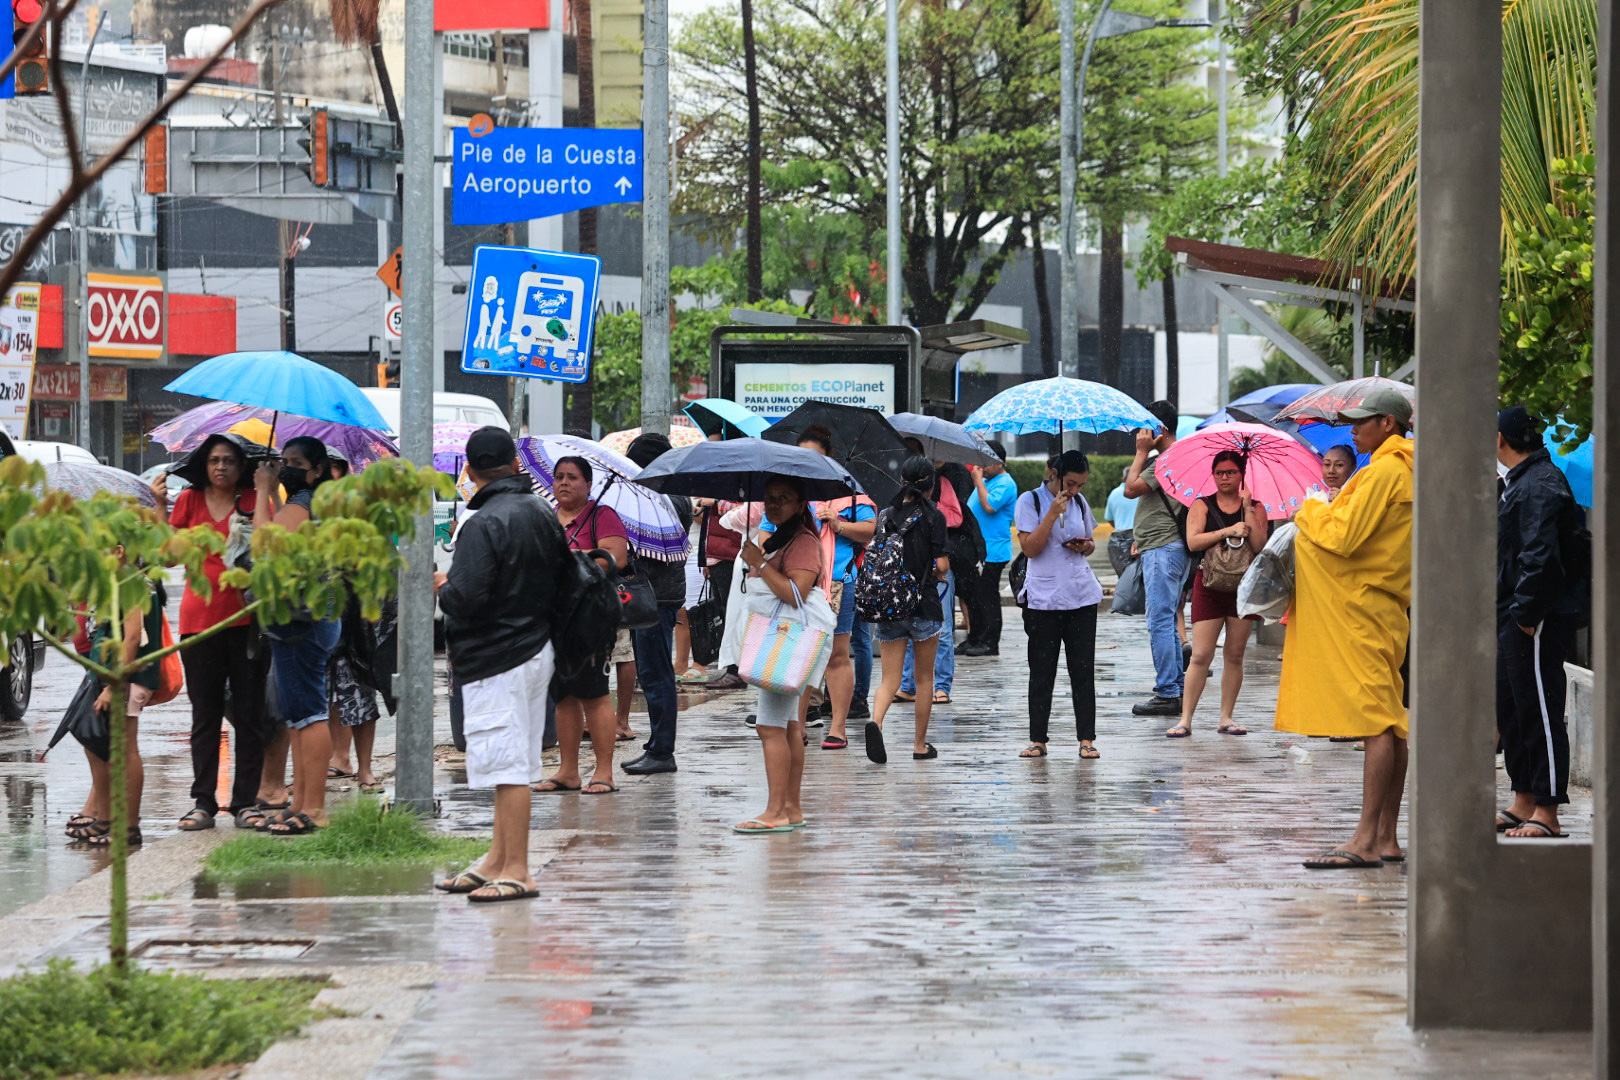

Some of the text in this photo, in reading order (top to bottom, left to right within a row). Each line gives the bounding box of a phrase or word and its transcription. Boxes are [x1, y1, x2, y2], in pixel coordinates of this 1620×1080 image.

[462, 143, 636, 165] Pie de la Cuesta
[463, 173, 591, 198] Aeropuerto
[88, 290, 160, 344] OXXO
[744, 380, 885, 392] CEMENTOS ECOPlanet
[744, 396, 769, 404] PARA
[770, 396, 790, 404] UNA
